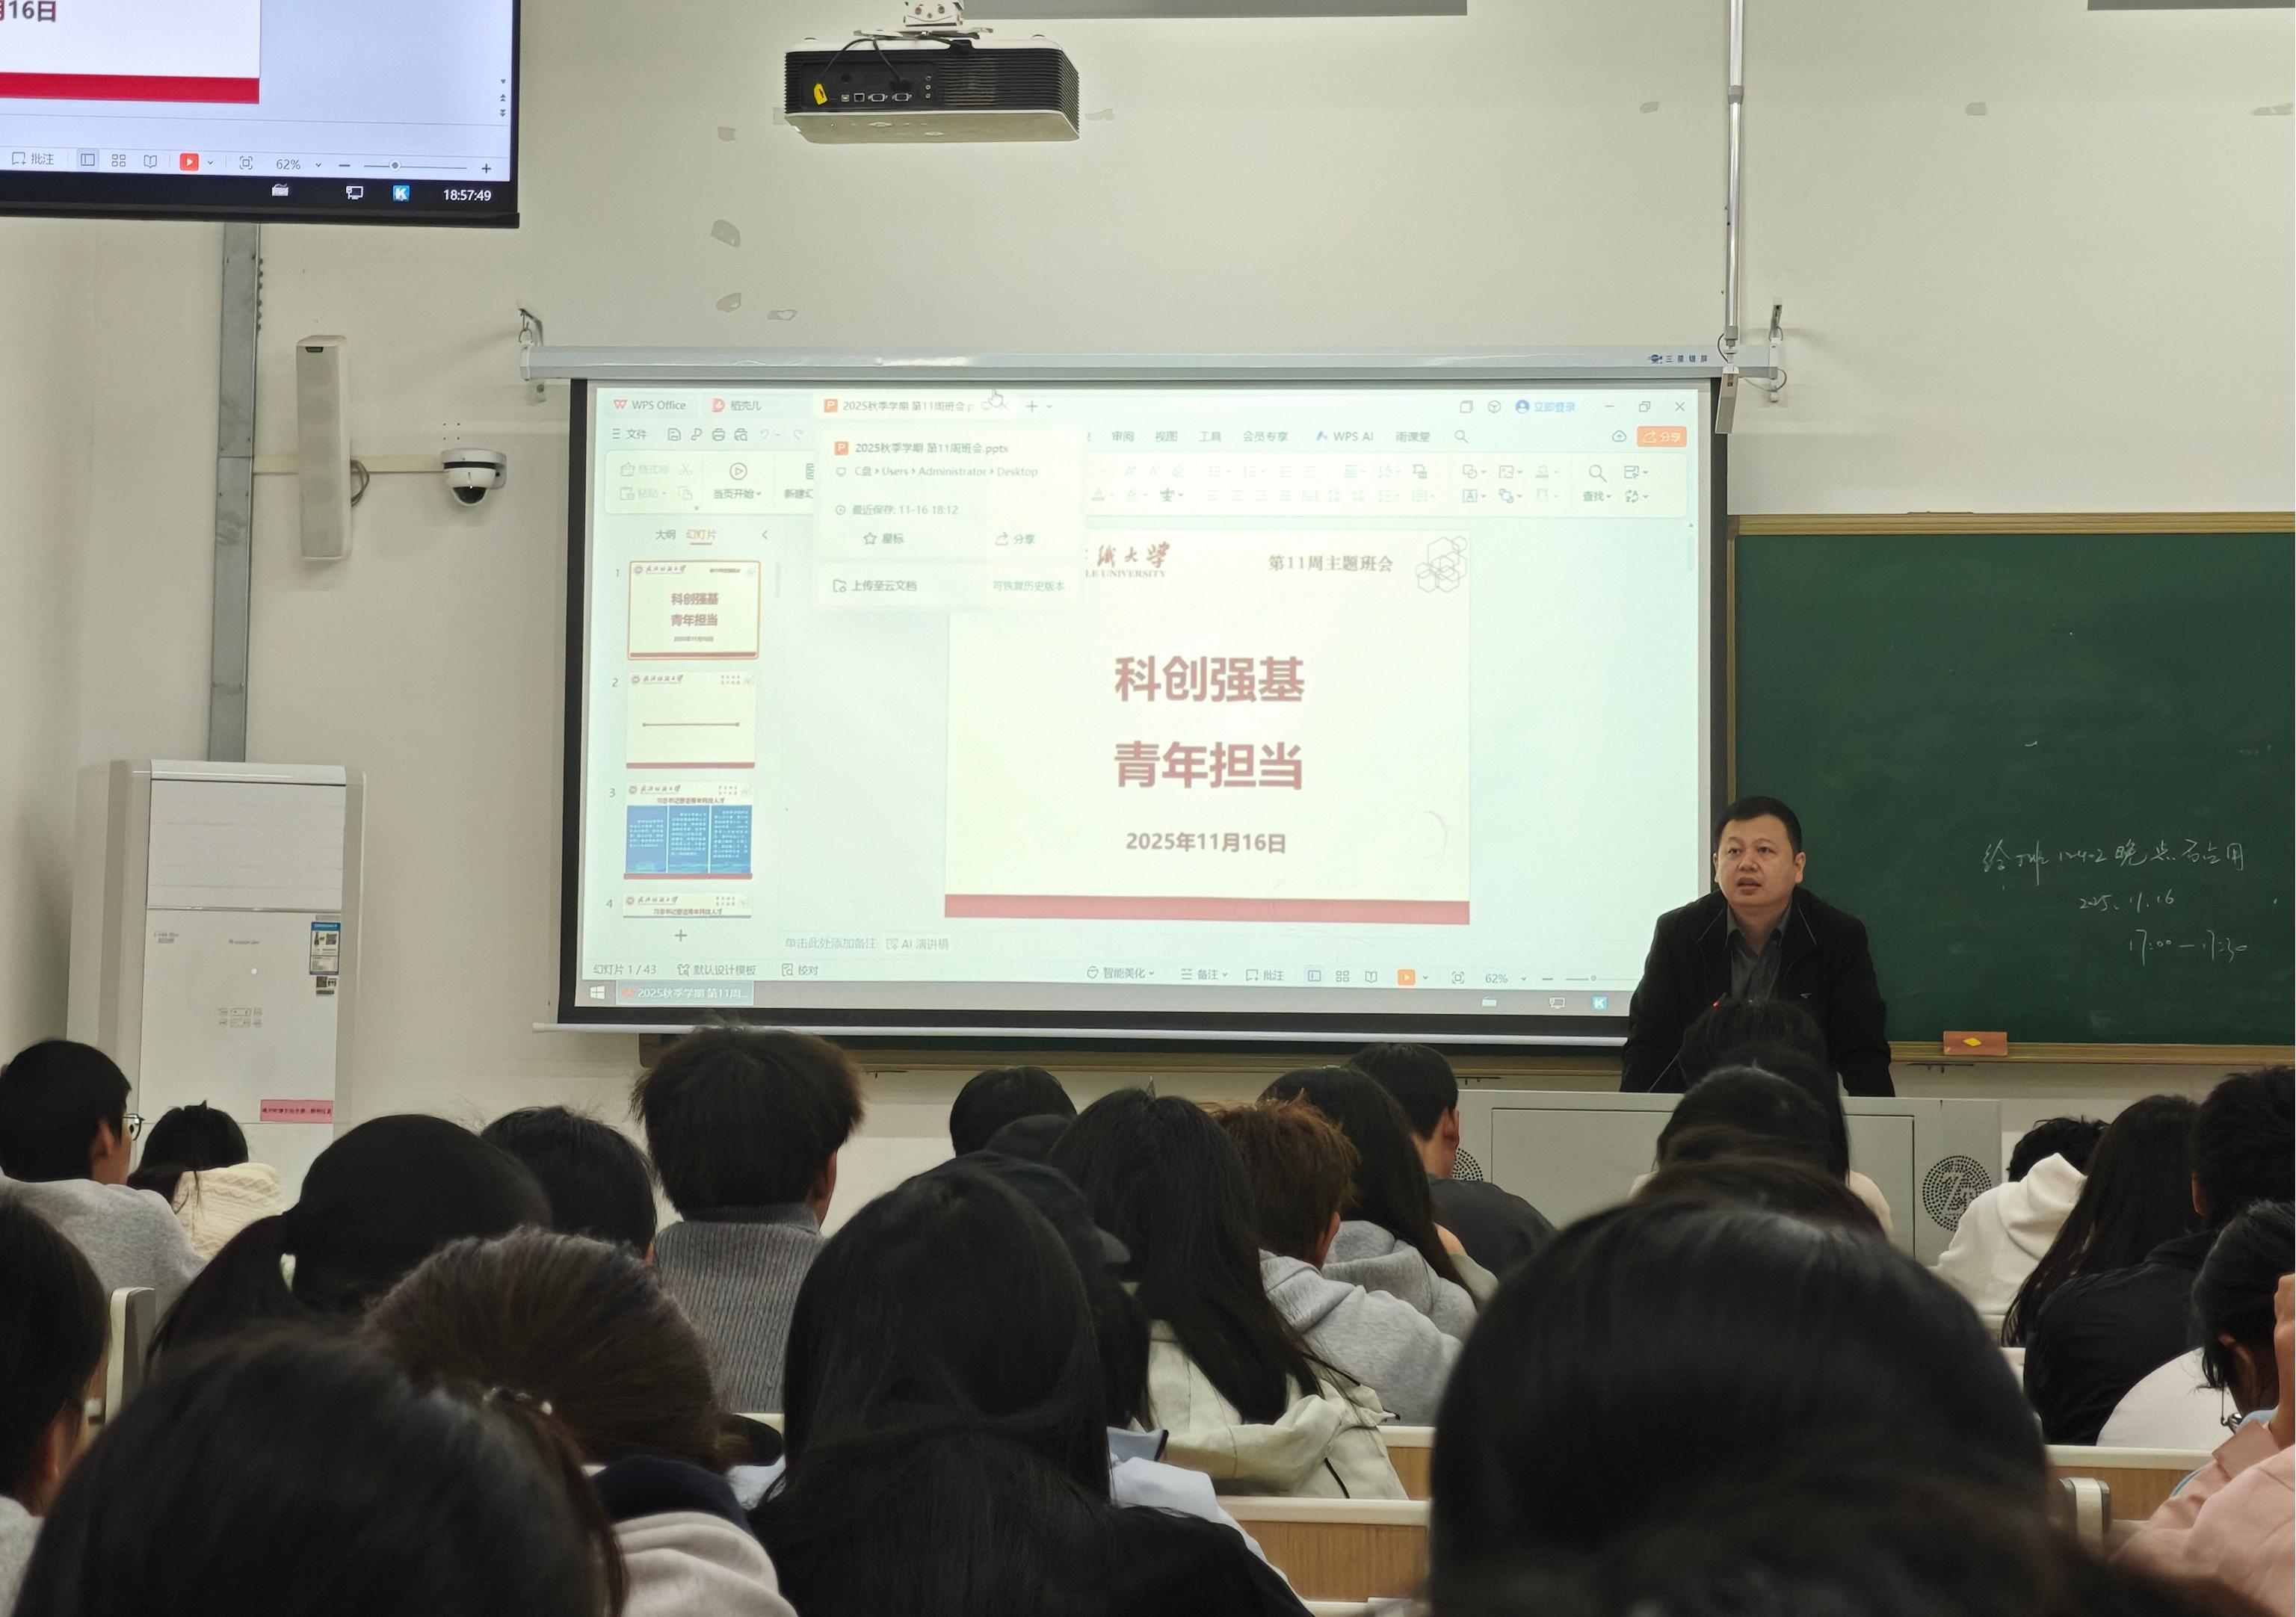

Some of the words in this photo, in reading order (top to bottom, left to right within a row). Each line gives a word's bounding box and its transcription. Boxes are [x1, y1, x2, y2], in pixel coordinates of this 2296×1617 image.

[0, 0, 56, 22] 16日
[31, 152, 55, 166] 批注
[276, 158, 301, 170] 62%
[443, 189, 491, 202] 18:57:49
[632, 401, 654, 410] WPS
[657, 400, 686, 410] Office
[1534, 400, 1576, 413] 立即登录
[626, 428, 647, 440] 文件
[1111, 430, 1135, 443] 审阅
[1155, 430, 1178, 443] 视图
[1198, 430, 1221, 443] 工具
[1243, 430, 1289, 443] 会员专享
[1333, 431, 1358, 442] WPS
[1362, 431, 1374, 442] AI
[1659, 430, 1681, 442] 分享
[855, 442, 924, 454] 2025秋季学期
[854, 466, 872, 477] C盘
[882, 466, 908, 477] Users
[919, 466, 987, 477] Administrator
[996, 466, 1039, 479] Desktop
[713, 488, 754, 499] 当页开始
[899, 504, 928, 515] 11-16
[932, 504, 959, 515] 18:12
[686, 528, 718, 540] 幻灯片
[882, 533, 904, 545] 星标
[1013, 534, 1036, 545] 分享
[1268, 554, 1394, 574] 第11周主题班会
[1102, 569, 1167, 578] UNIVERSITY
[851, 580, 918, 593] 上传至云文档
[993, 580, 1065, 593] 可恢复历史版本
[611, 678, 619, 688] 2
[1114, 655, 1306, 703] 科创强基
[1114, 740, 1303, 791] 青年担当
[608, 788, 616, 799] 3
[1126, 832, 1287, 854] 2025年11月16日
[605, 899, 614, 909] 4
[785, 937, 877, 950] 单击此处添加备注
[901, 939, 913, 950] AI
[593, 963, 623, 975] 幻灯片
[694, 964, 756, 976] 默认设计模板
[798, 965, 819, 976] 校对
[1103, 967, 1145, 979] 智能美化
[1197, 969, 1218, 980] 备注
[1263, 970, 1284, 981] 批注
[1485, 973, 1508, 984] 62%
